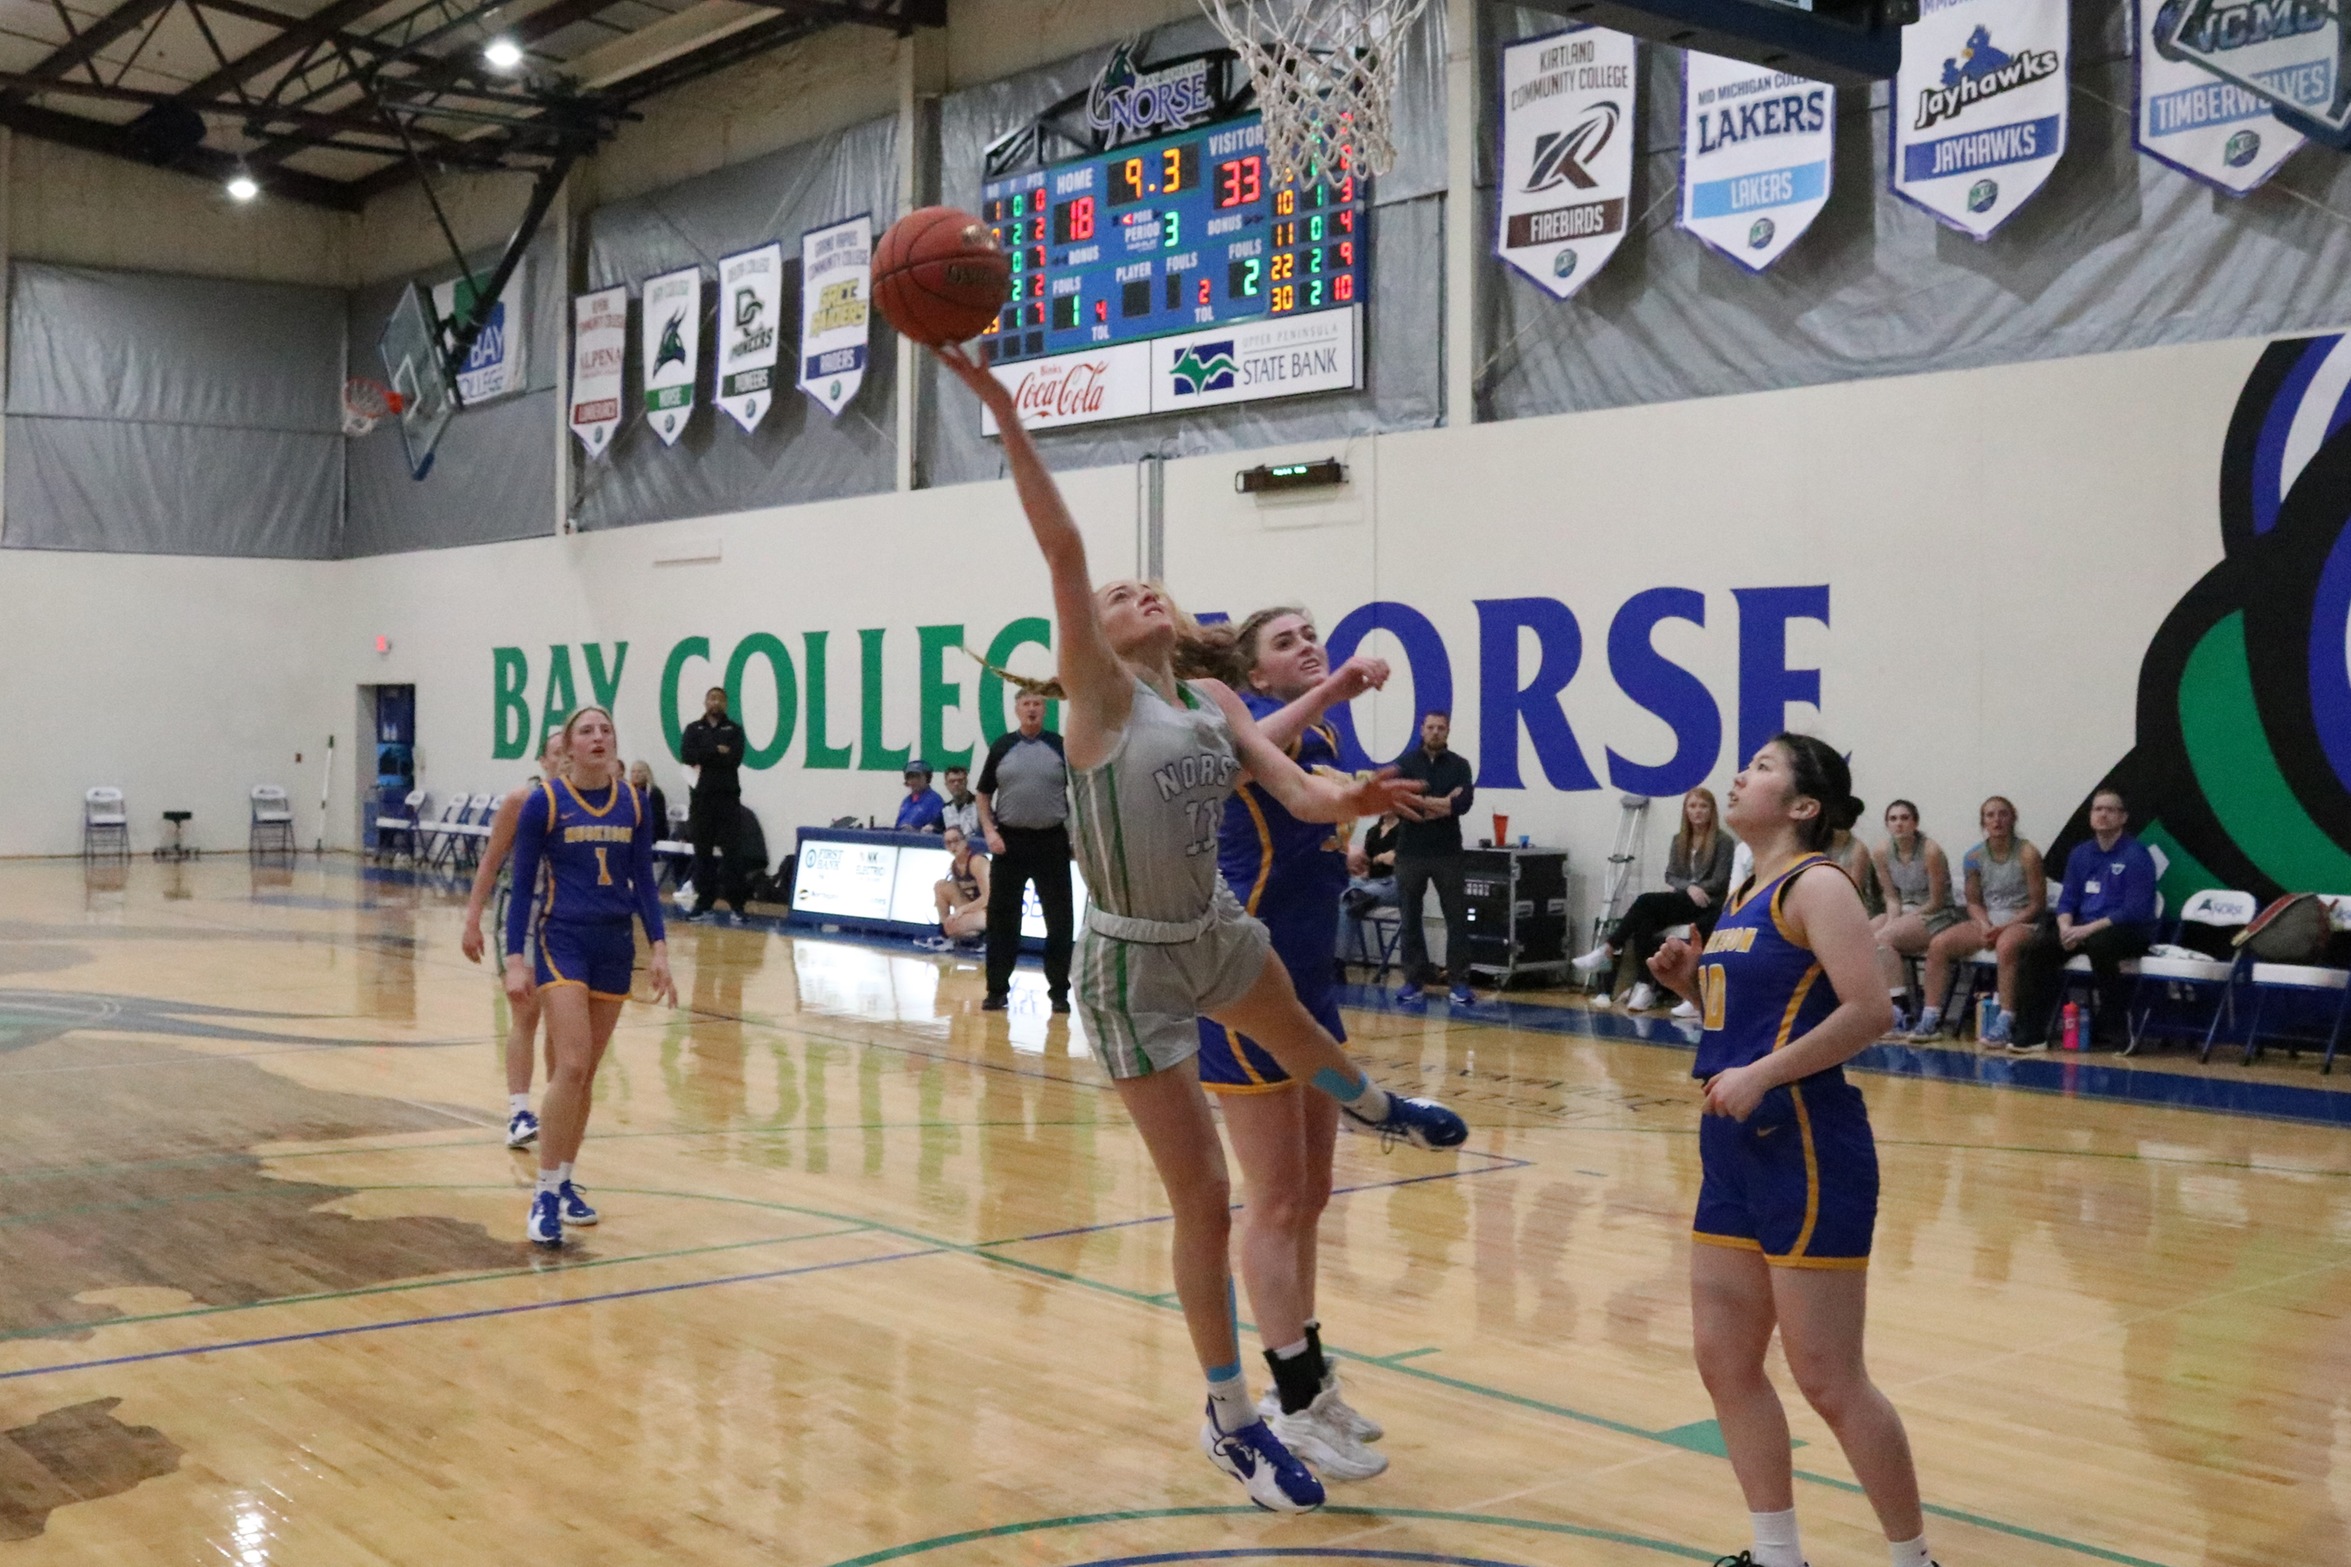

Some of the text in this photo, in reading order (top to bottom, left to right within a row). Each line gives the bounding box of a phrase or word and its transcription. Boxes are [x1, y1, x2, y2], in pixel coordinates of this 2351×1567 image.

[1540, 40, 1595, 73] KIRTLAND
[1511, 65, 1628, 111] COMMUNITY COLLEGE
[1718, 76, 1772, 100] MICHIGAN
[1914, 49, 2059, 130] Jayhawks
[1087, 71, 1213, 150] NORSE
[1697, 90, 1824, 155] LAKERS
[1932, 123, 2036, 174] JAYHAWKS
[1057, 167, 1093, 195] HOME
[1222, 155, 1261, 208] 33
[1277, 189, 1294, 215] 10
[1341, 177, 1353, 203] 3
[1731, 172, 1793, 209] LAKERS
[1013, 195, 1023, 218] 0
[1035, 188, 1046, 212] 0
[1070, 195, 1095, 241] 18
[1013, 223, 1023, 246] 2
[1035, 217, 1046, 240] 2
[1125, 221, 1160, 242] PERIOD
[1165, 211, 1179, 248] 3
[1208, 214, 1242, 236] BONUS
[1277, 209, 1353, 247] 11 0 4
[1530, 205, 1604, 242] FIREBIRDS
[1012, 251, 1022, 273] 0
[1035, 245, 1046, 267] 7
[1068, 245, 1099, 265] BONUS
[1166, 252, 1198, 273] FOULS
[1228, 238, 1262, 260] FOULS
[1271, 241, 1353, 281] 22 2 9
[1012, 274, 1045, 301] 2 2
[1053, 276, 1081, 295] FOULS
[1116, 261, 1151, 283] PLAYER
[1243, 258, 1260, 296] 2
[1198, 278, 1211, 305] 2
[1271, 274, 1353, 312] 30 2 10
[1035, 302, 1045, 324] 7
[1073, 294, 1080, 327] 1
[1096, 300, 1107, 321] 4
[1195, 305, 1214, 323] TOL
[1092, 325, 1109, 341] TOL
[1243, 323, 1338, 348] UPPER PENINSULA
[1243, 347, 1337, 385] STATE BANK
[1013, 361, 1110, 416] Coca-Cola
[491, 584, 1850, 797] BAY COLLEG ORSE
[595, 847, 613, 886] 1
